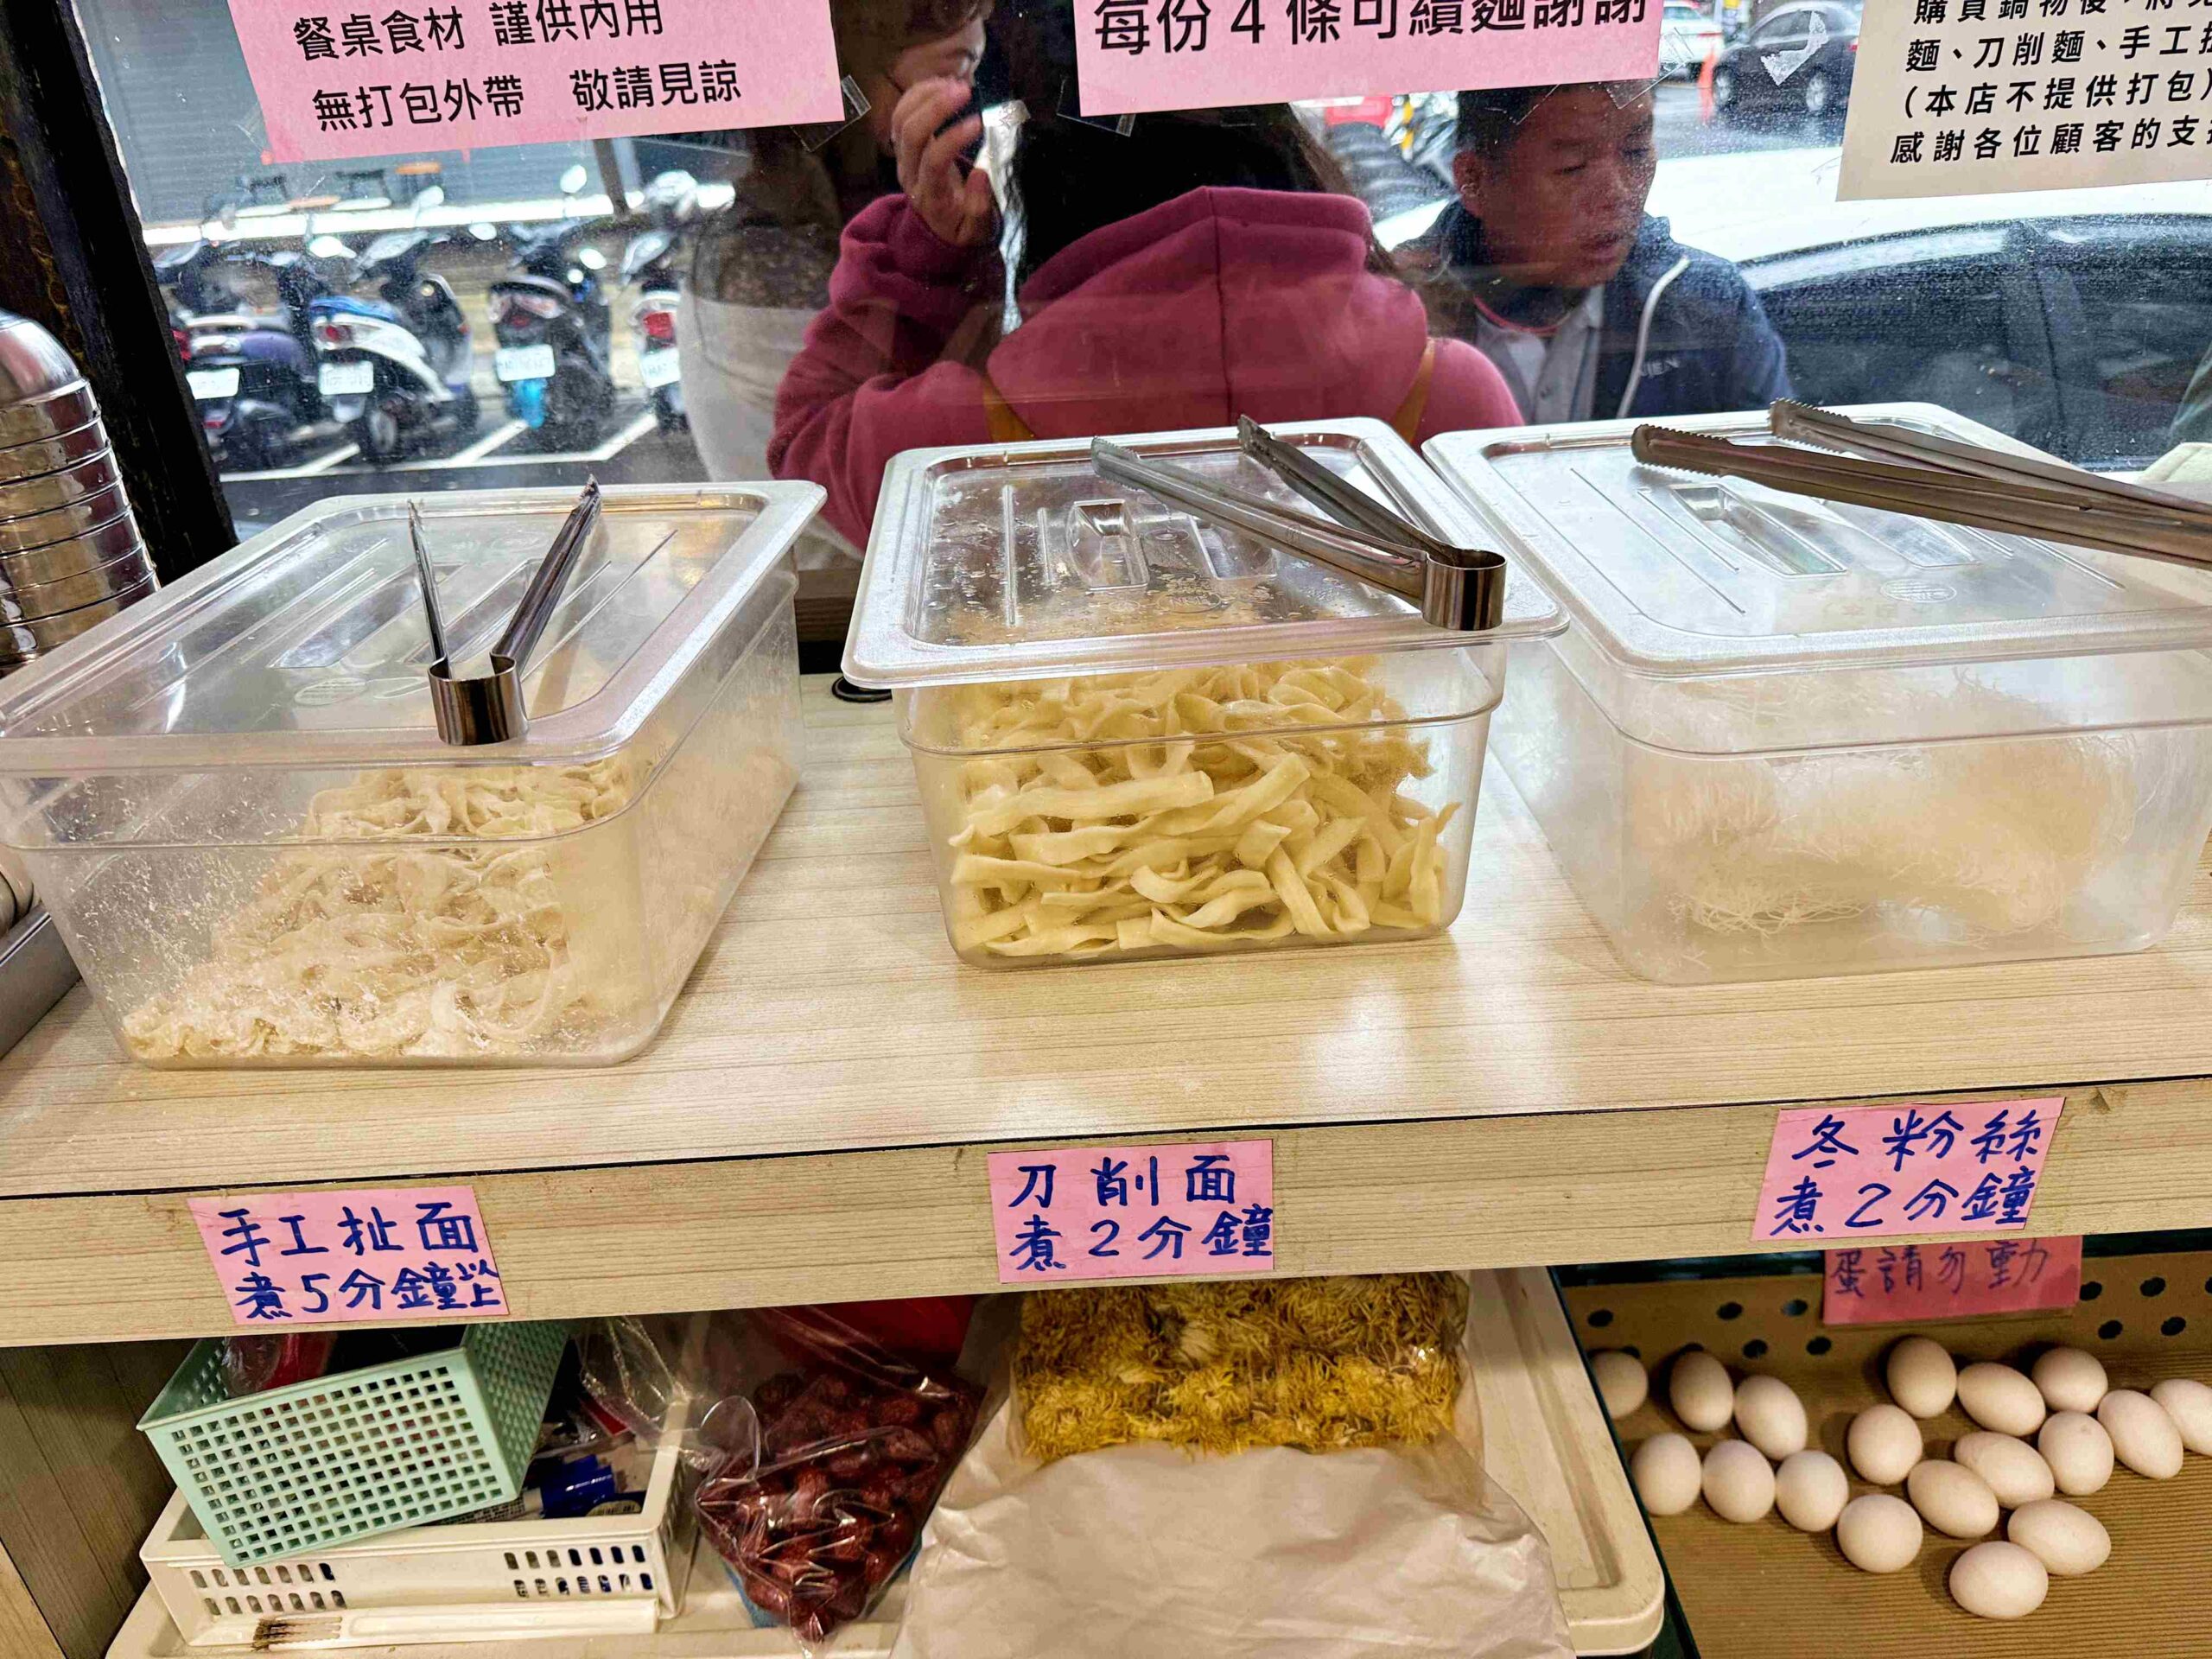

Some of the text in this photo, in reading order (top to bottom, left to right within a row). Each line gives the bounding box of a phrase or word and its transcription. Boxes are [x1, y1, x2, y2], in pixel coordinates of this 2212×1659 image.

[294, 5, 464, 60] 餐桌食材
[312, 60, 741, 131] 無打包外帶 敬請見諒
[1891, 115, 2212, 163] 感謝各位顧客的支
[1792, 1109, 2041, 1172] 冬粉絲
[1008, 1155, 1236, 1208] 刀削面
[1770, 1166, 2035, 1236] 煮2分鐘
[219, 1202, 479, 1267] 手工扯面
[1009, 1204, 1274, 1271] 煮2分鐘
